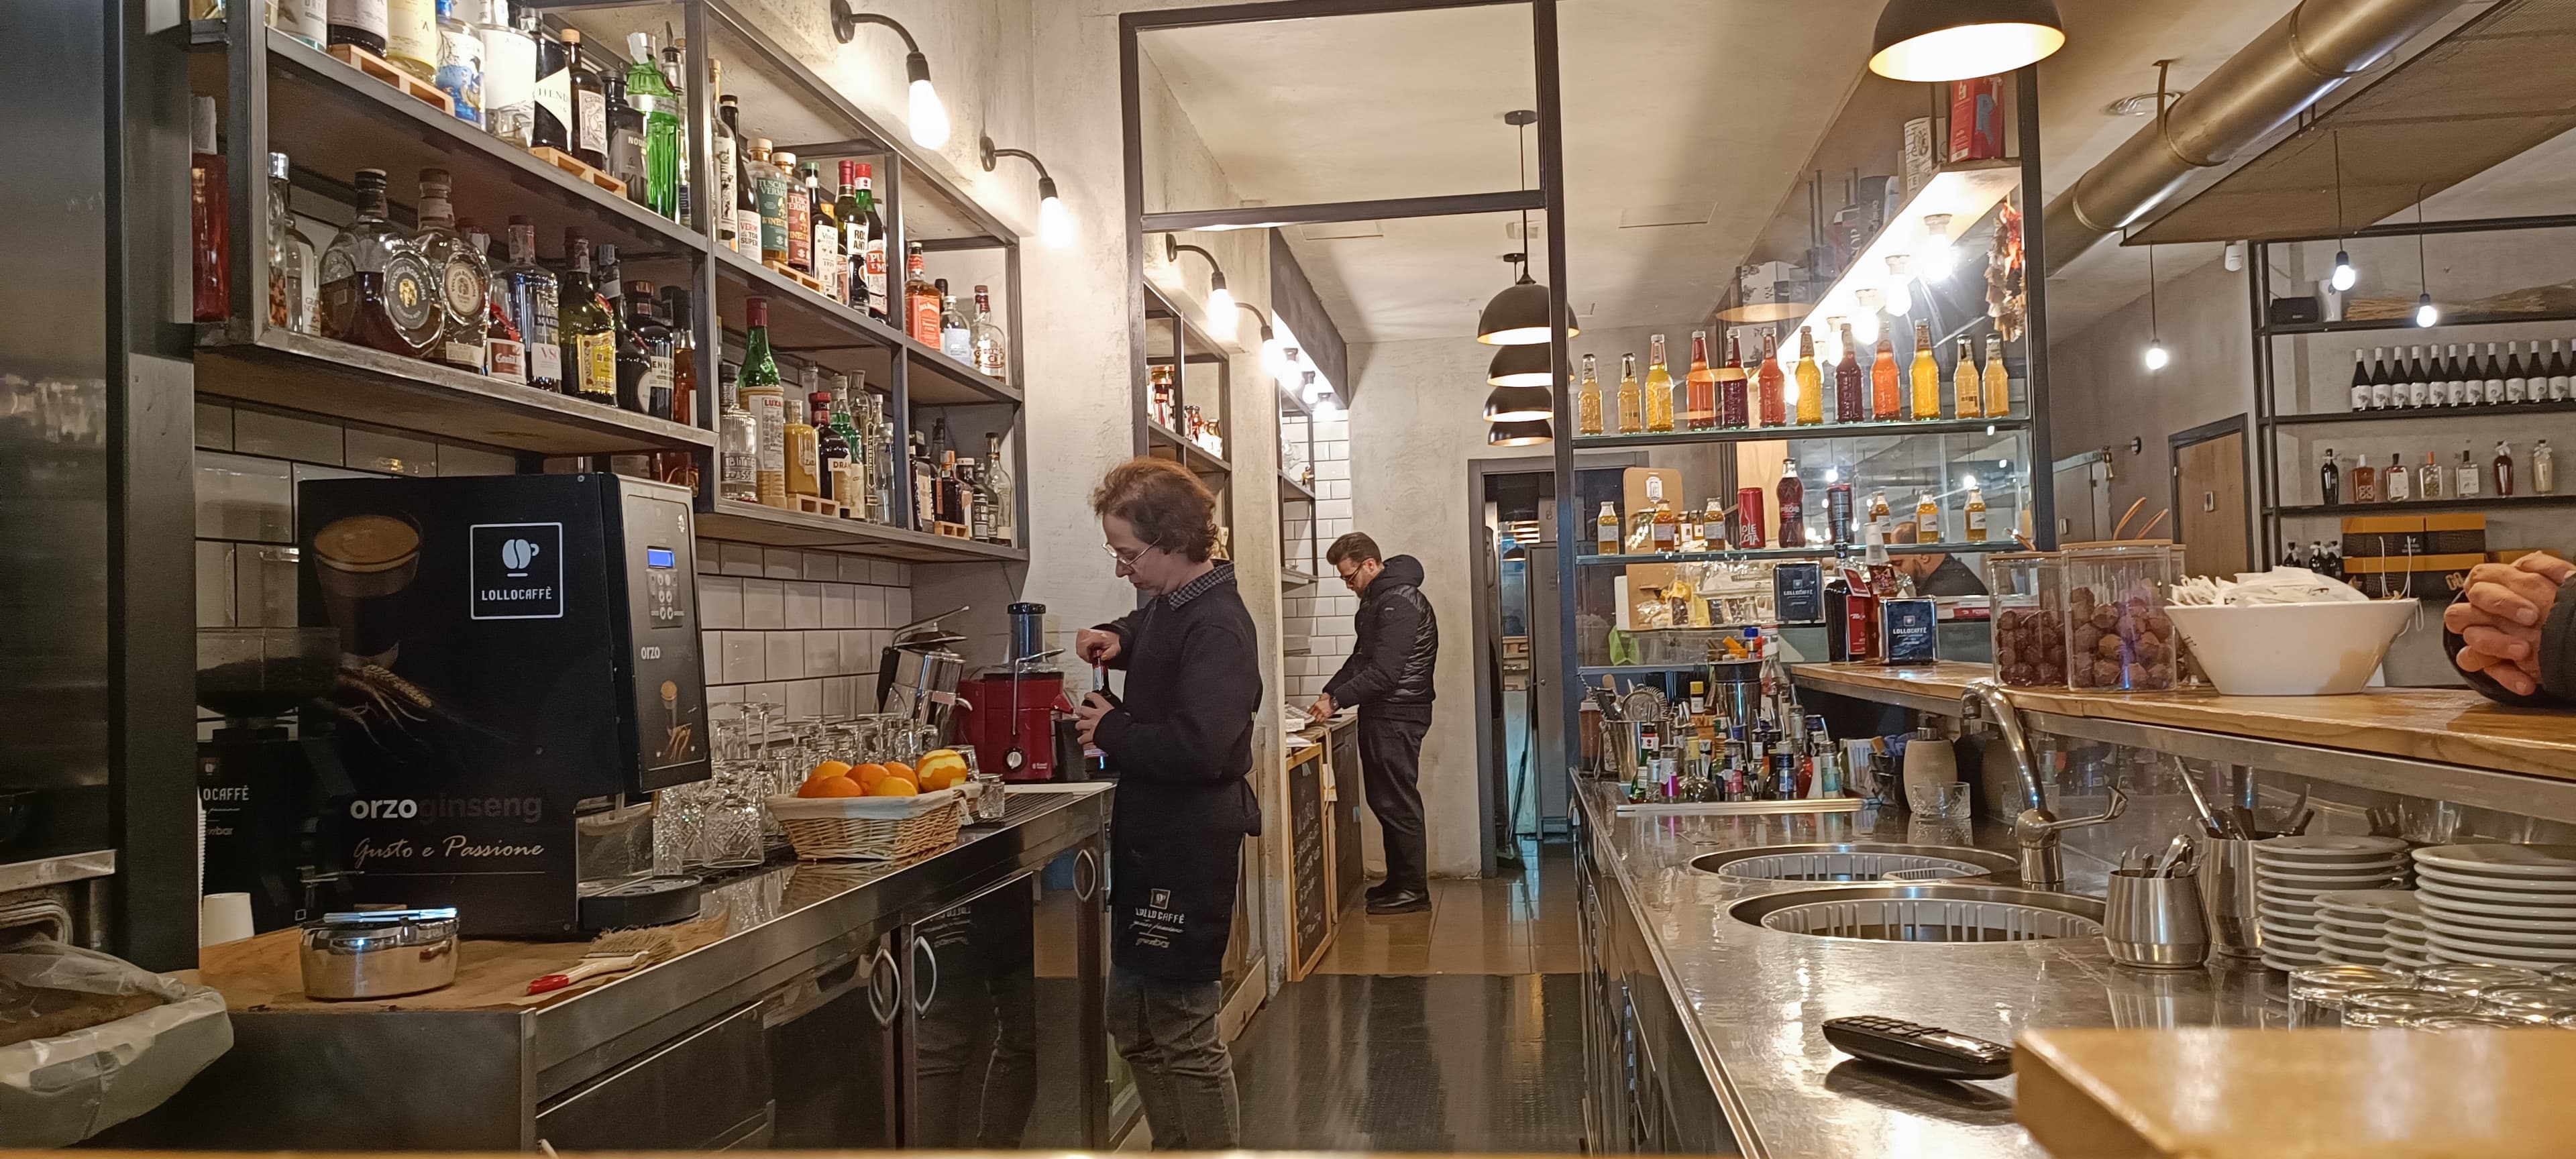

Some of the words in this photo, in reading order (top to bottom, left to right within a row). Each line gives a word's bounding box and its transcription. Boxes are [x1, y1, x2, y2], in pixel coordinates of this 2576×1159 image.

[481, 586, 553, 601] LOLLOCAFFÈ
[641, 647, 661, 660] orzo
[350, 799, 418, 819] orzo
[353, 837, 413, 869] Gusto
[421, 845, 435, 858] e
[442, 834, 545, 858] Passione
